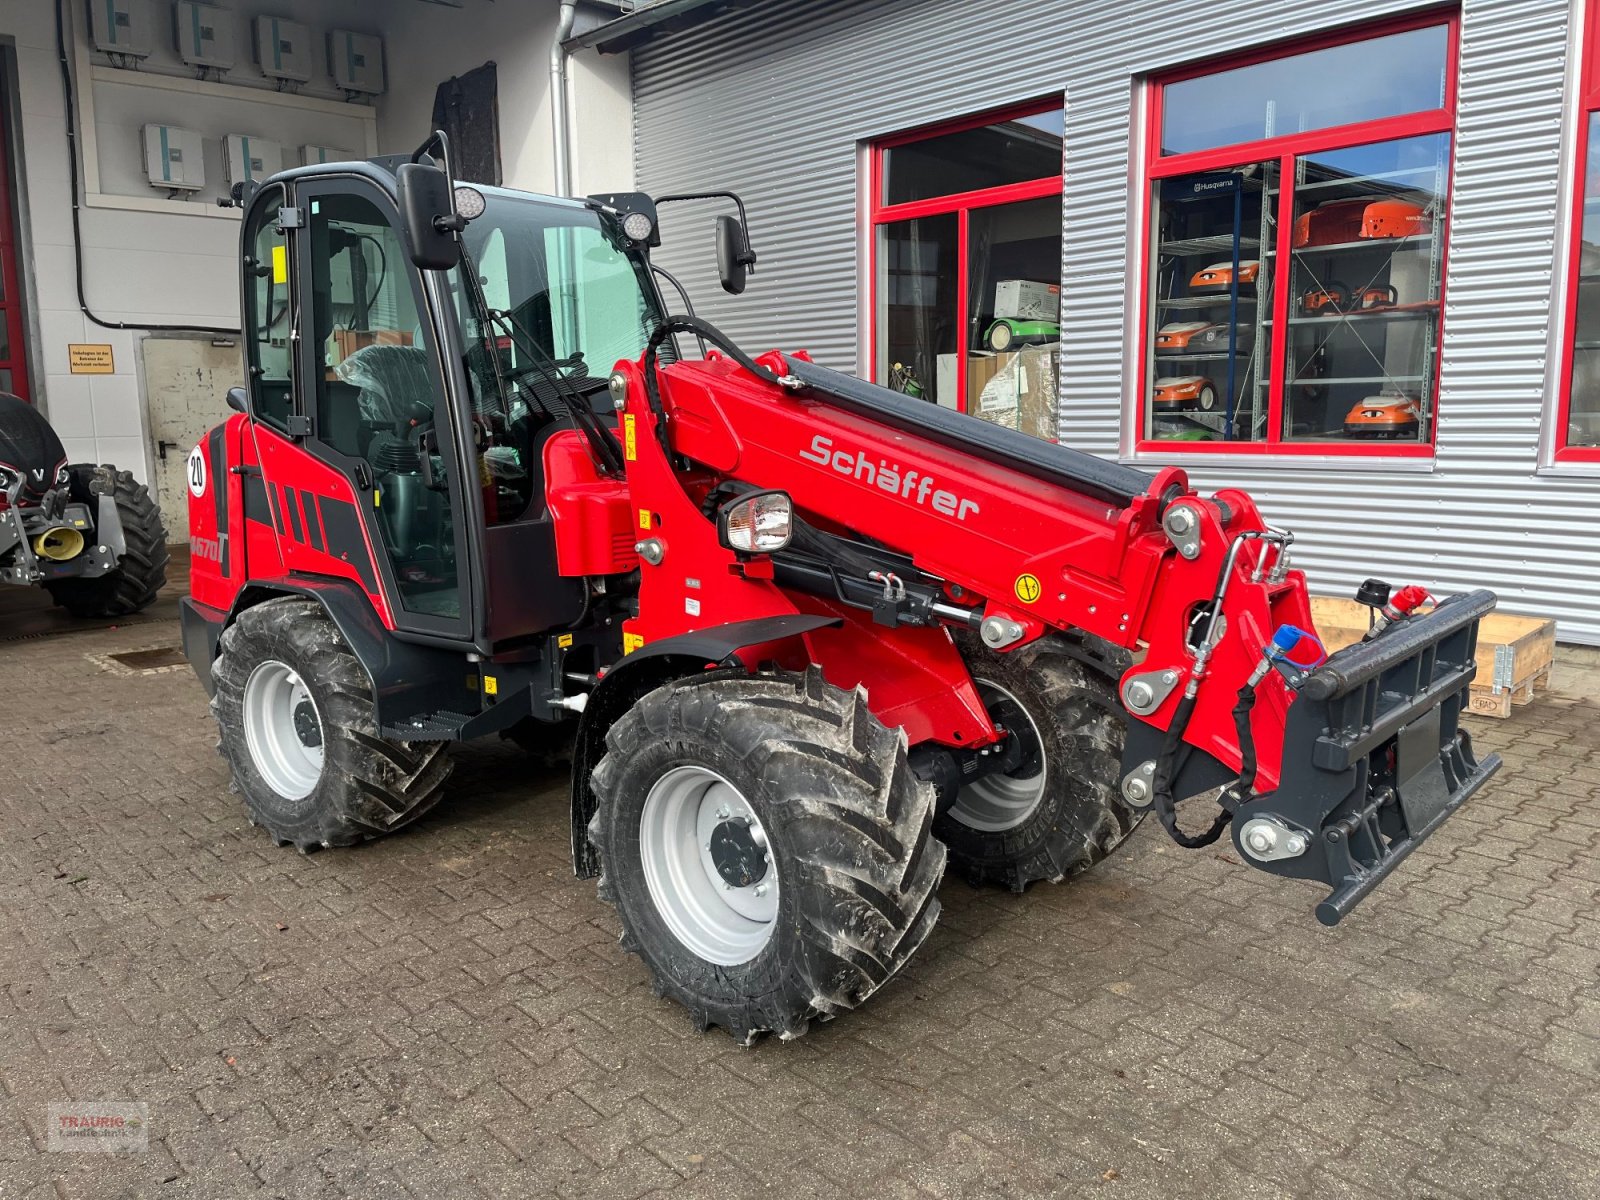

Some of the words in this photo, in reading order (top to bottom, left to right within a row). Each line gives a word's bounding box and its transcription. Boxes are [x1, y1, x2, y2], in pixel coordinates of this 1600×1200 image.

[1200, 180, 1233, 190] Husqvarna
[191, 455, 203, 487] 20
[799, 434, 980, 521] Schäffer
